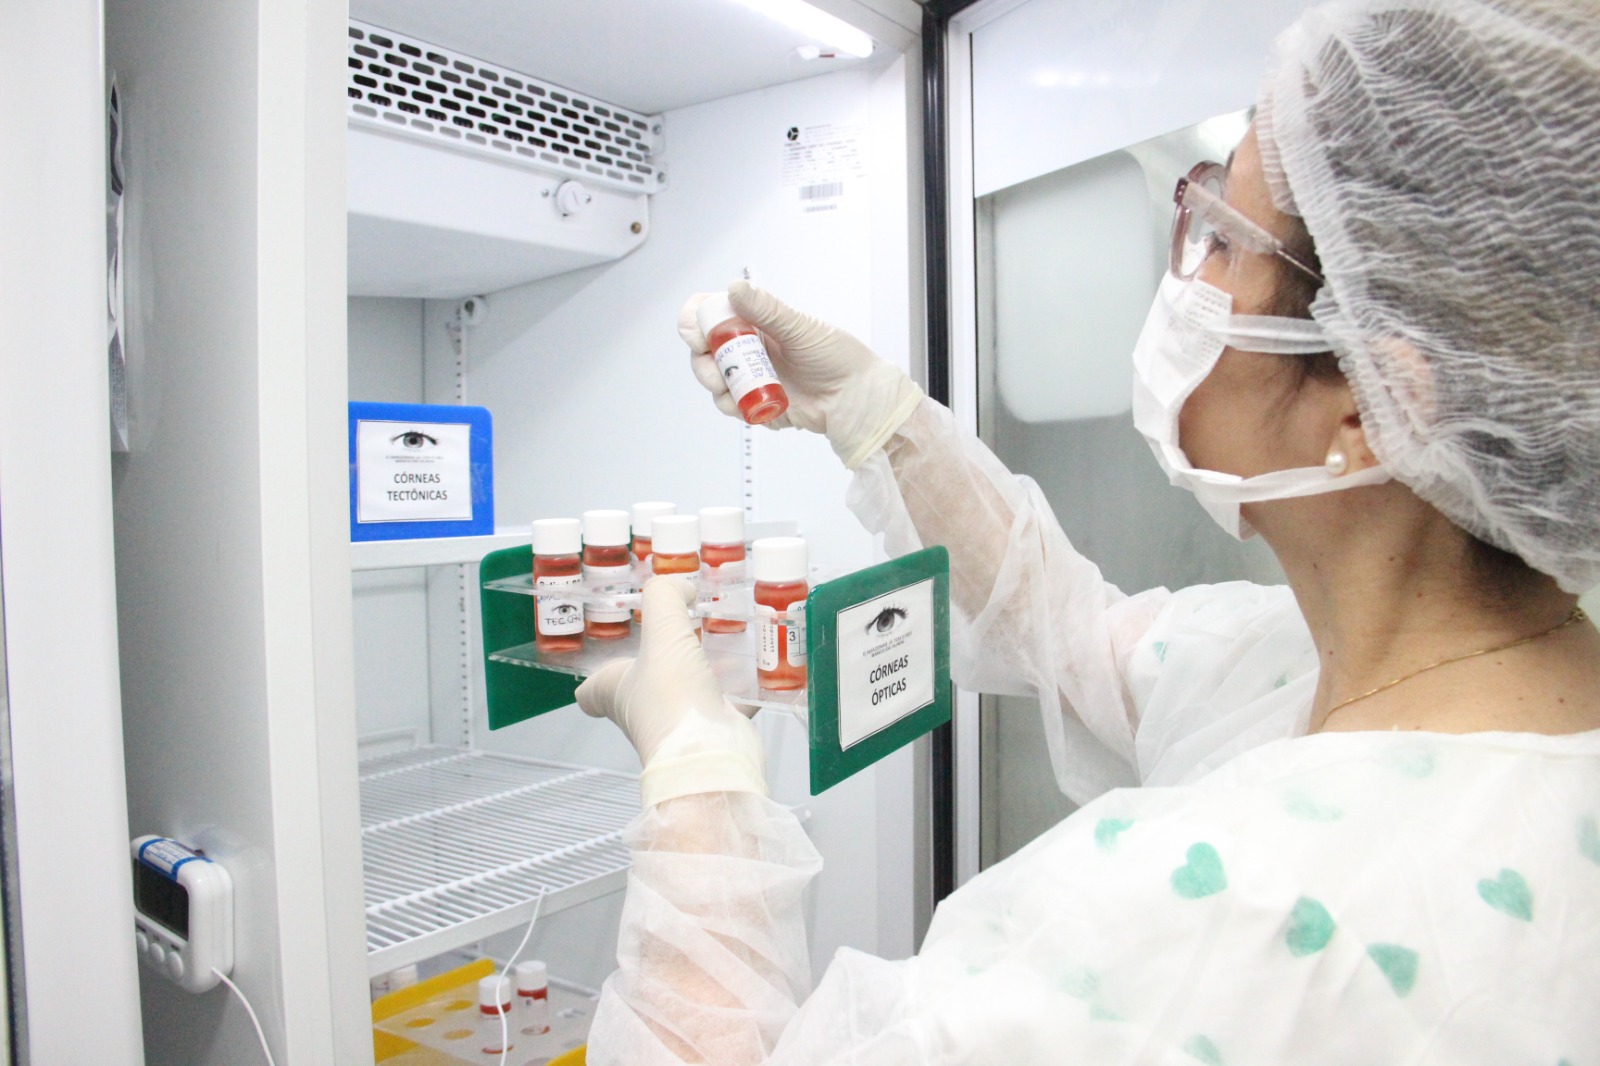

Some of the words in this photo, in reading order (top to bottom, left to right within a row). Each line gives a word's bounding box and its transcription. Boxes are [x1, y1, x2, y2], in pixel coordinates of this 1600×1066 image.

[394, 471, 441, 484] CÓRNEAS
[386, 488, 448, 501] TECTÔNICAS
[789, 630, 796, 642] 3
[870, 654, 908, 684] CÓRNEAS
[872, 677, 907, 706] ÓPTICAS
